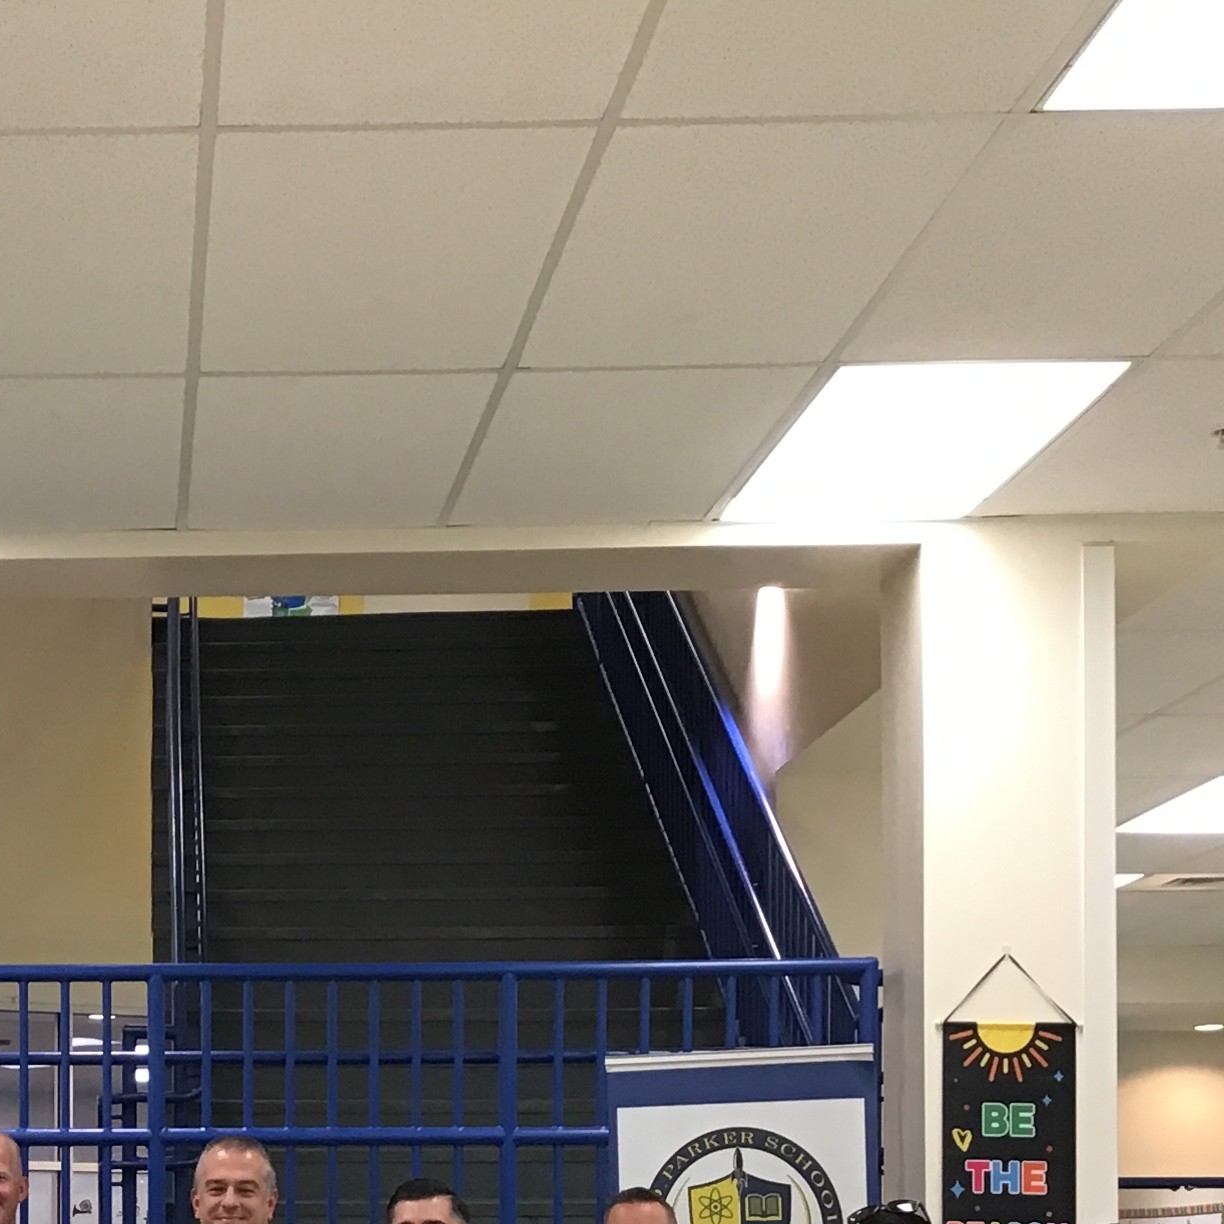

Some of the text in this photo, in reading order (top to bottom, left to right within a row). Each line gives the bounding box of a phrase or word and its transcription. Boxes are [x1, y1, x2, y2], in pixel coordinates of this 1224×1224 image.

[981, 1102, 1036, 1138] BE
[662, 1131, 754, 1180] PARKER
[965, 1159, 1048, 1196] THE
